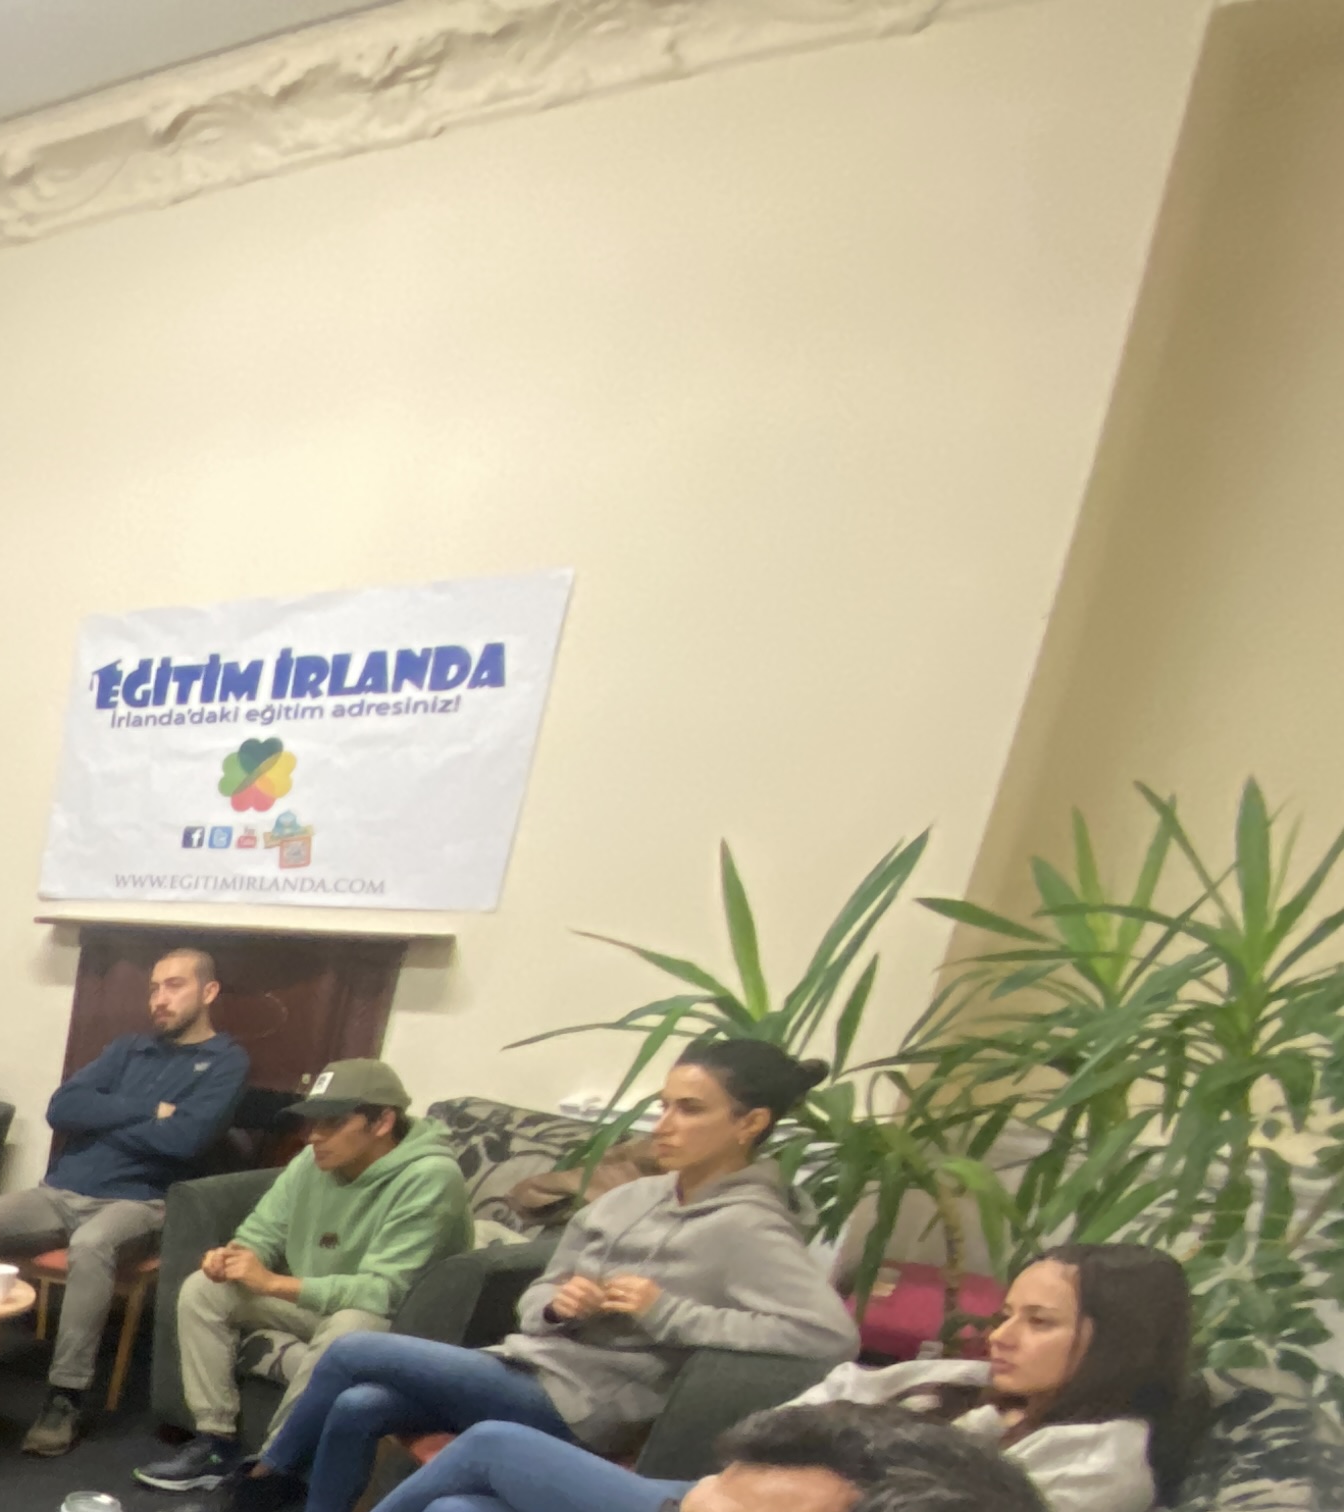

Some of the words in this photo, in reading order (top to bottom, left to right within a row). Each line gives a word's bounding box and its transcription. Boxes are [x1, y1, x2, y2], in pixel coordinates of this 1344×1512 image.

[96, 653, 265, 710] EĞİTİM
[271, 642, 506, 700] İRLANDA
[245, 702, 324, 726] eğitim
[331, 694, 462, 719] adresiniz!
